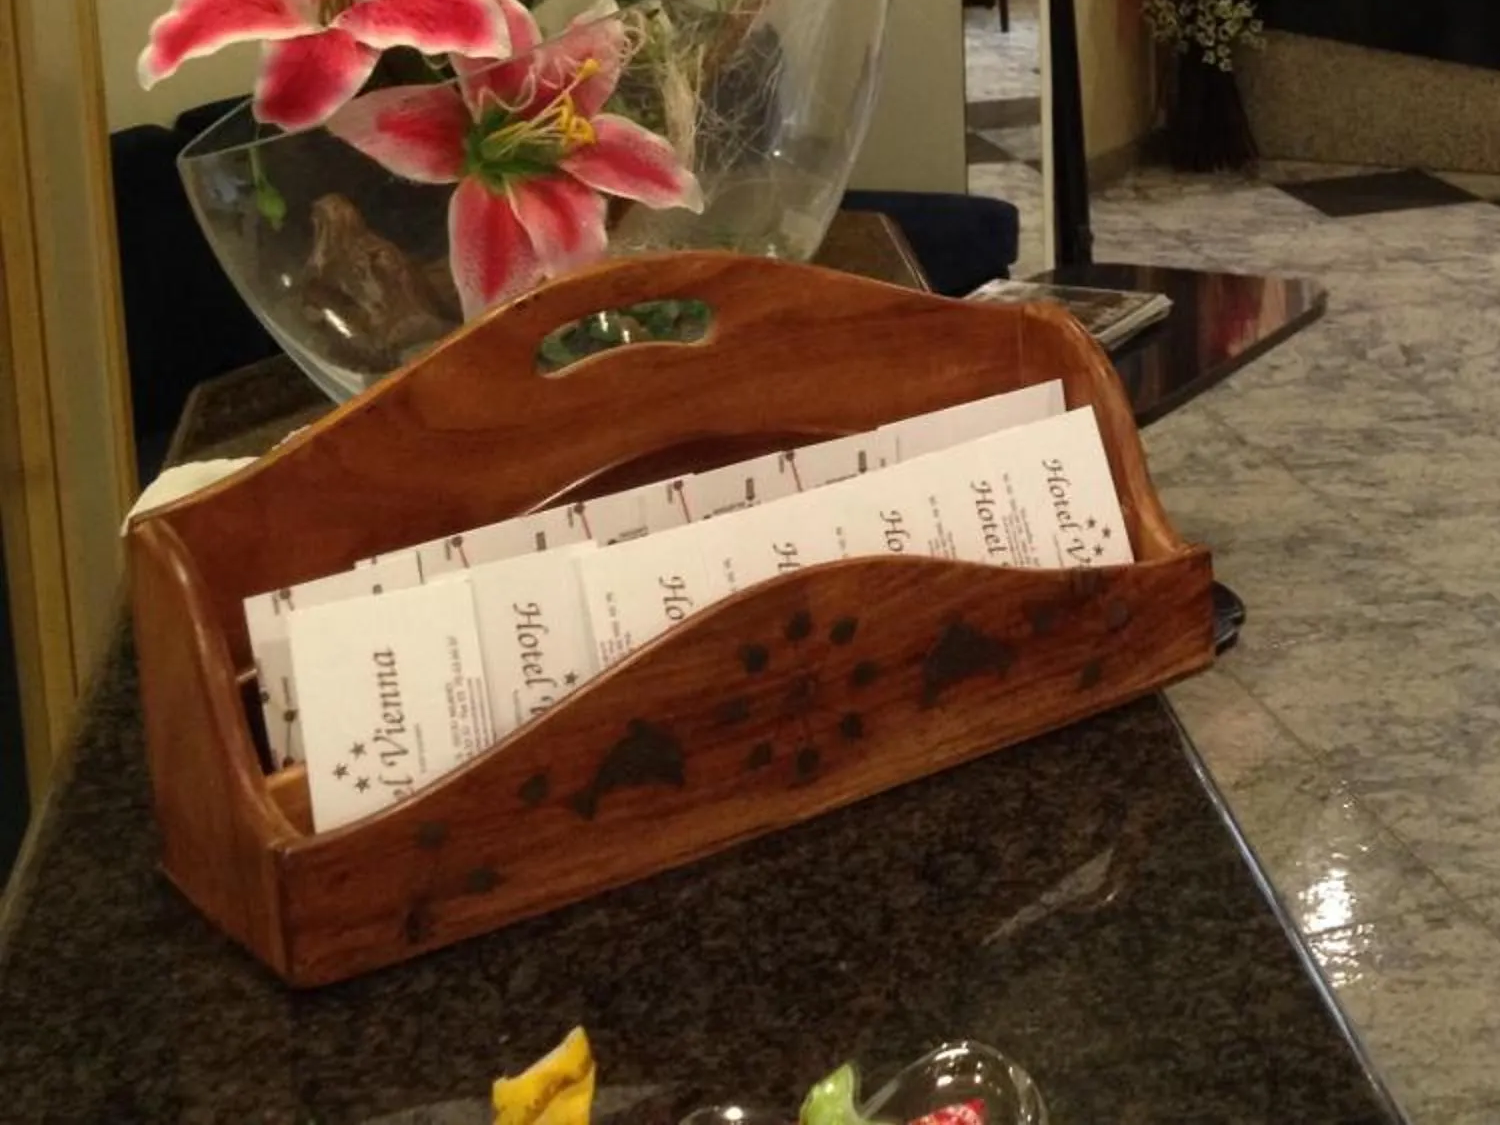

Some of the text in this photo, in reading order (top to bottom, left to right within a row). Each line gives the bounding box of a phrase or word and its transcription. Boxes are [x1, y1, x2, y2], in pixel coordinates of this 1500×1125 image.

[970, 480, 1008, 556] Hotel
[1041, 458, 1083, 532] Hotel
[512, 602, 558, 688] Hotel
[372, 647, 410, 768] Vienna
